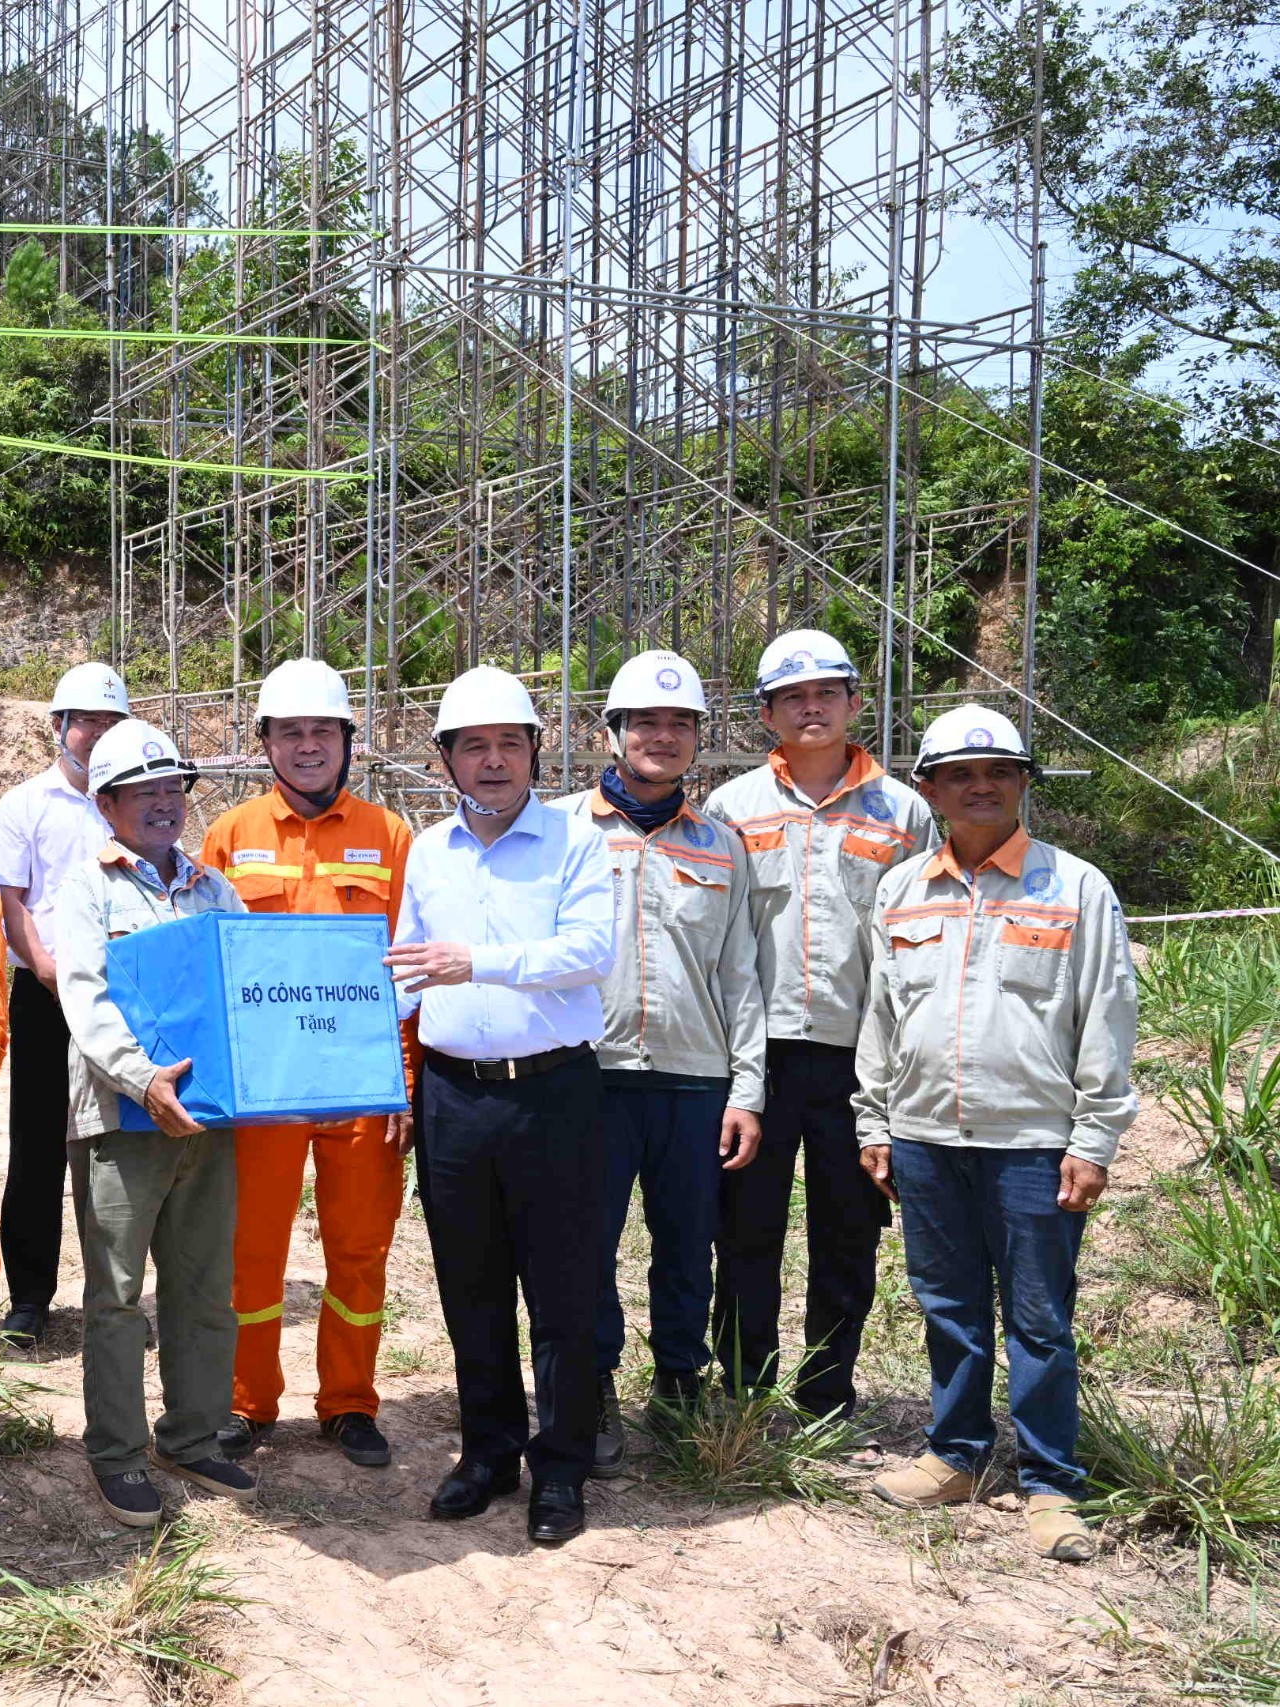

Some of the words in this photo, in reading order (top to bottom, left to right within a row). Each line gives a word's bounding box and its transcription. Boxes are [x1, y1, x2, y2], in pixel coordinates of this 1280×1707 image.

[242, 982, 262, 1007] BỘ
[268, 982, 312, 1003] CÔNG
[316, 984, 379, 1002] THƯƠNG
[296, 1013, 336, 1034] Tặng
